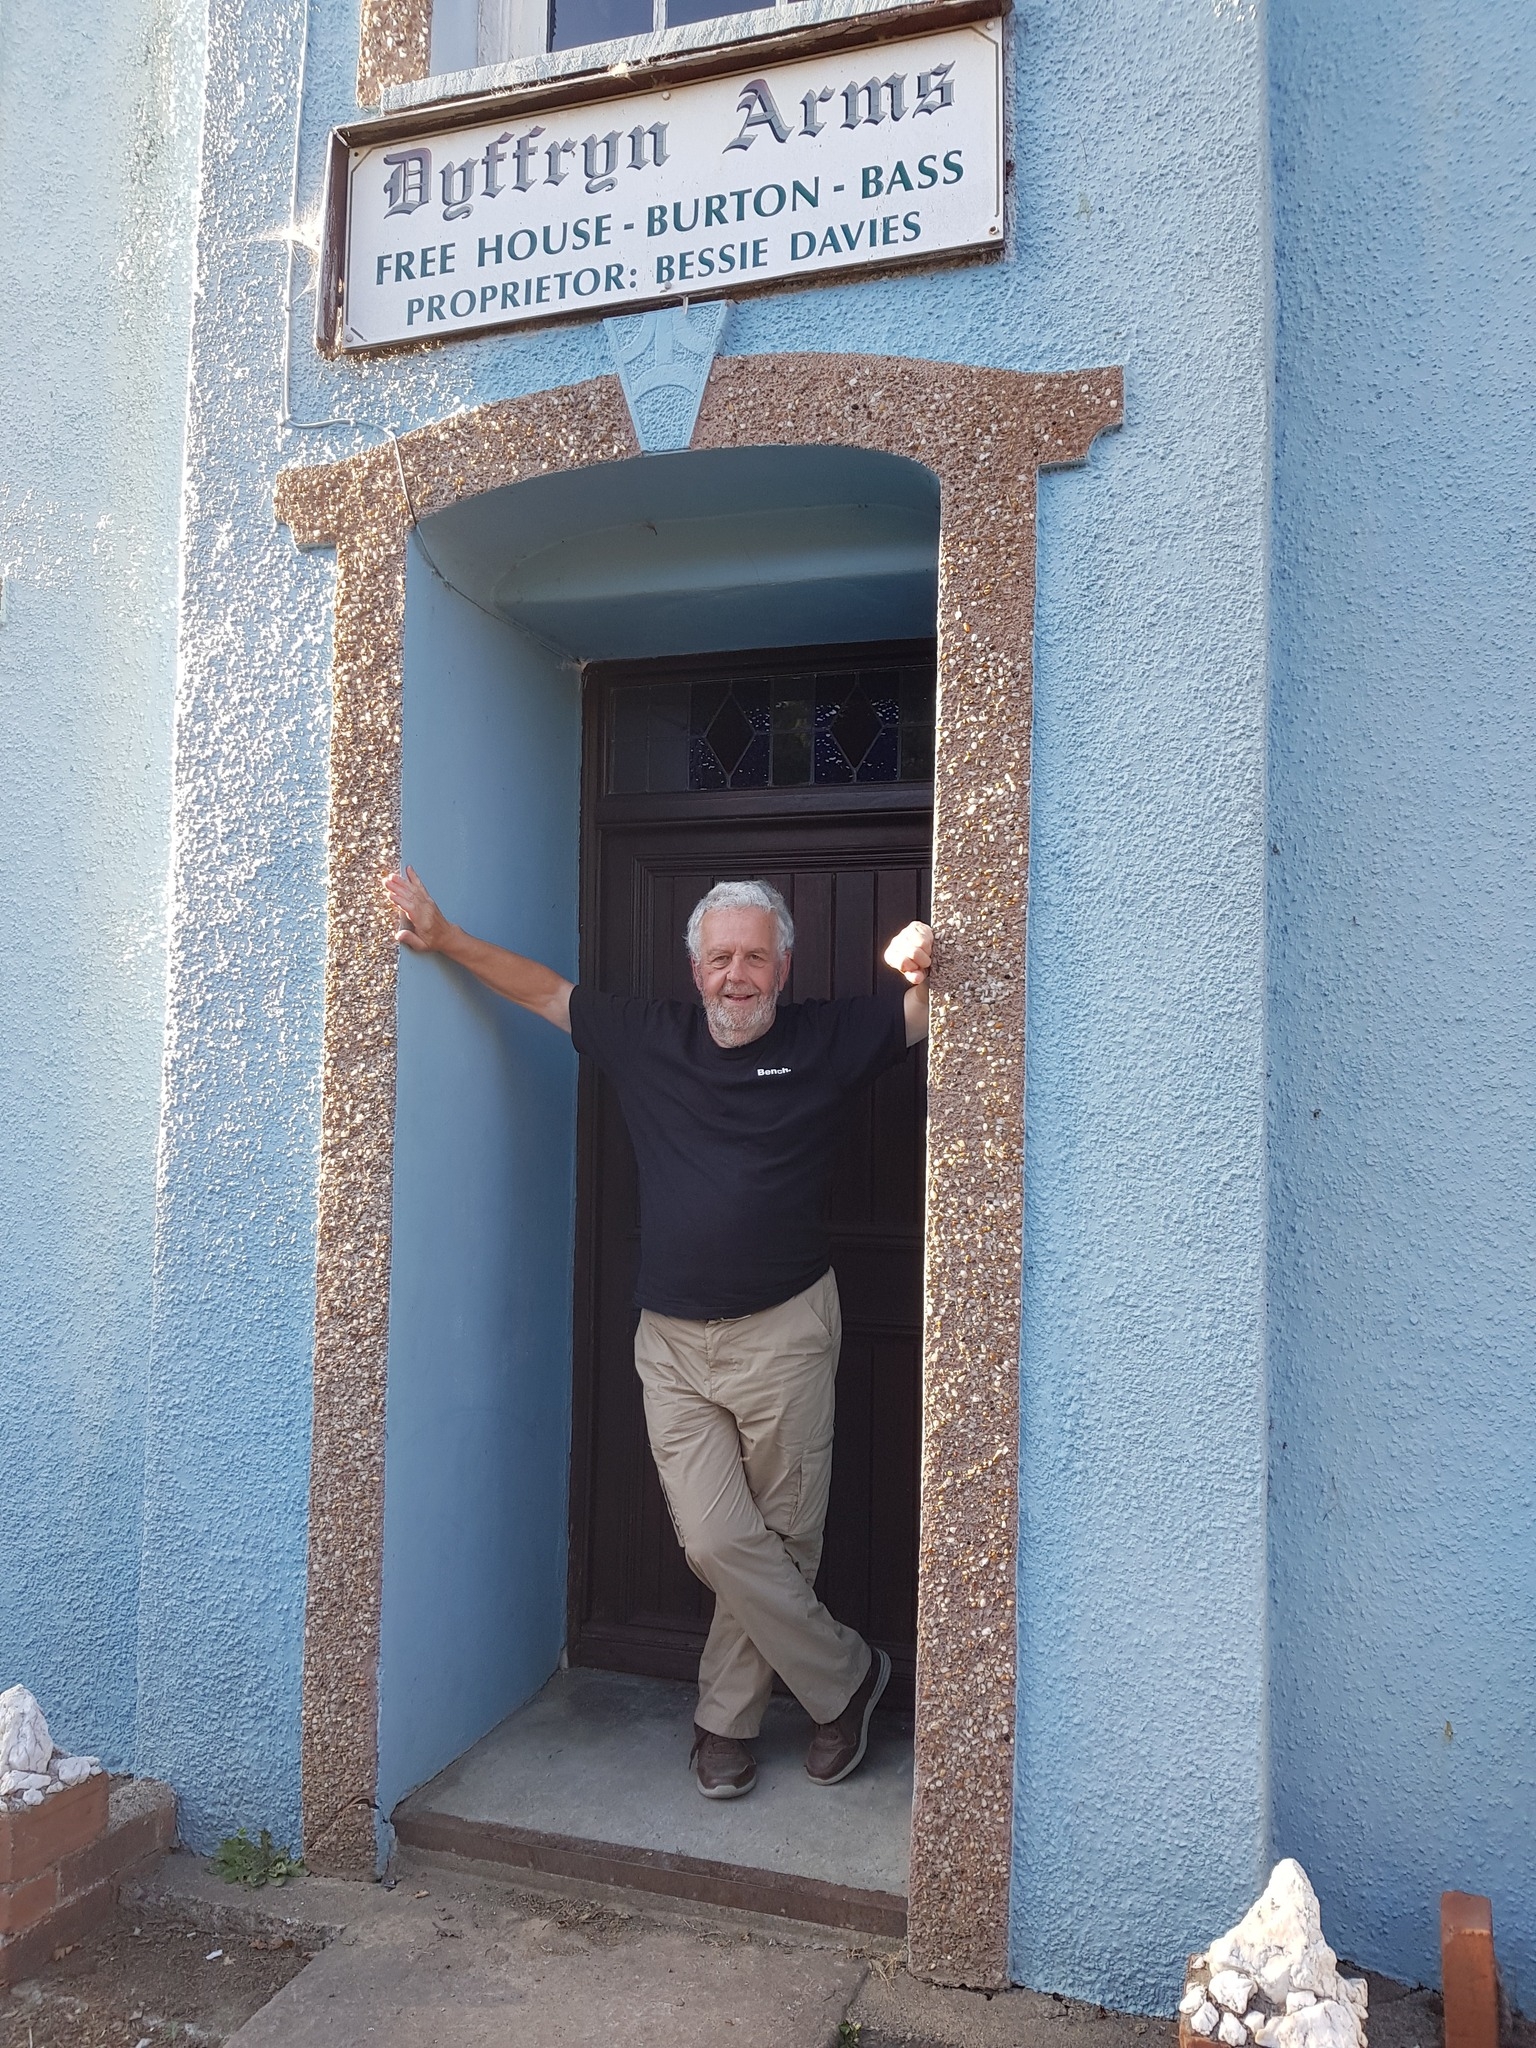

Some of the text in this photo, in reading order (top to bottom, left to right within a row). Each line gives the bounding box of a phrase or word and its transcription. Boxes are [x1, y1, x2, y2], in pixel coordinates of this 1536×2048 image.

[383, 61, 956, 221] Dyffryn Arms
[376, 242, 456, 286] FREE
[477, 213, 612, 267] HOUSE
[646, 177, 820, 238] BURTON
[861, 150, 964, 199] BASS
[406, 211, 921, 326] PROPRIETOR: BESSIE DAVIES
